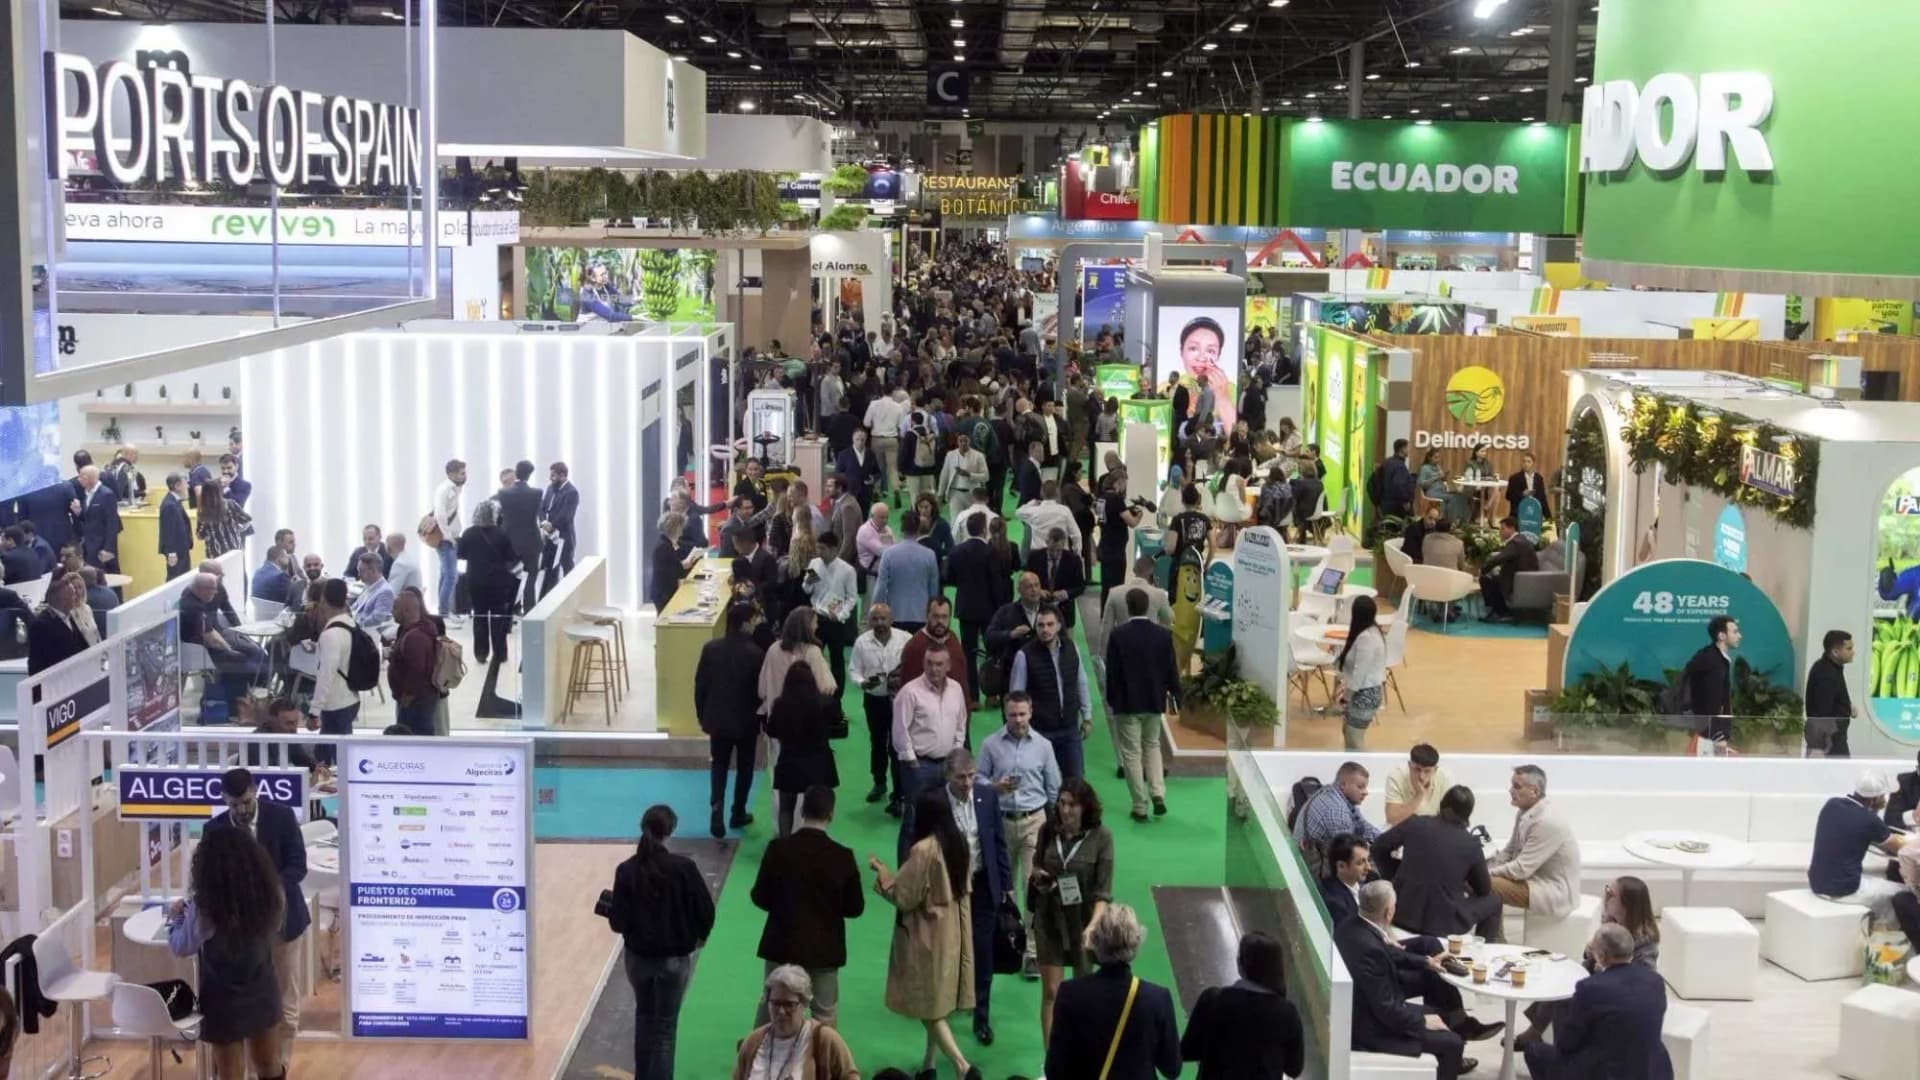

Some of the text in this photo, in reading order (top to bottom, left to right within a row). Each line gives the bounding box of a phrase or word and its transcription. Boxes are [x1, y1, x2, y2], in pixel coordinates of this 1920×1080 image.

[936, 71, 960, 101] C
[44, 51, 422, 188] PORTS OF SPAIN
[1331, 161, 1518, 194] ECUADOR
[1101, 193, 1130, 205] Chile
[107, 209, 164, 230] ahora
[211, 211, 335, 238] revver
[354, 218, 375, 234] La
[381, 221, 425, 240] may
[1051, 221, 1118, 235] Argentina
[826, 261, 868, 271] Alonso
[1415, 430, 1530, 450] Delindecsa
[1742, 446, 1794, 491] PALMAR
[1632, 591, 1730, 614] 48 YEARS
[48, 699, 77, 729] VIGO
[377, 762, 425, 770] ALGECIRAS
[128, 776, 293, 801] ALGECAS
[357, 886, 456, 897] PUESTO DE CONTROL
[357, 896, 417, 906] FRONTERIZO
